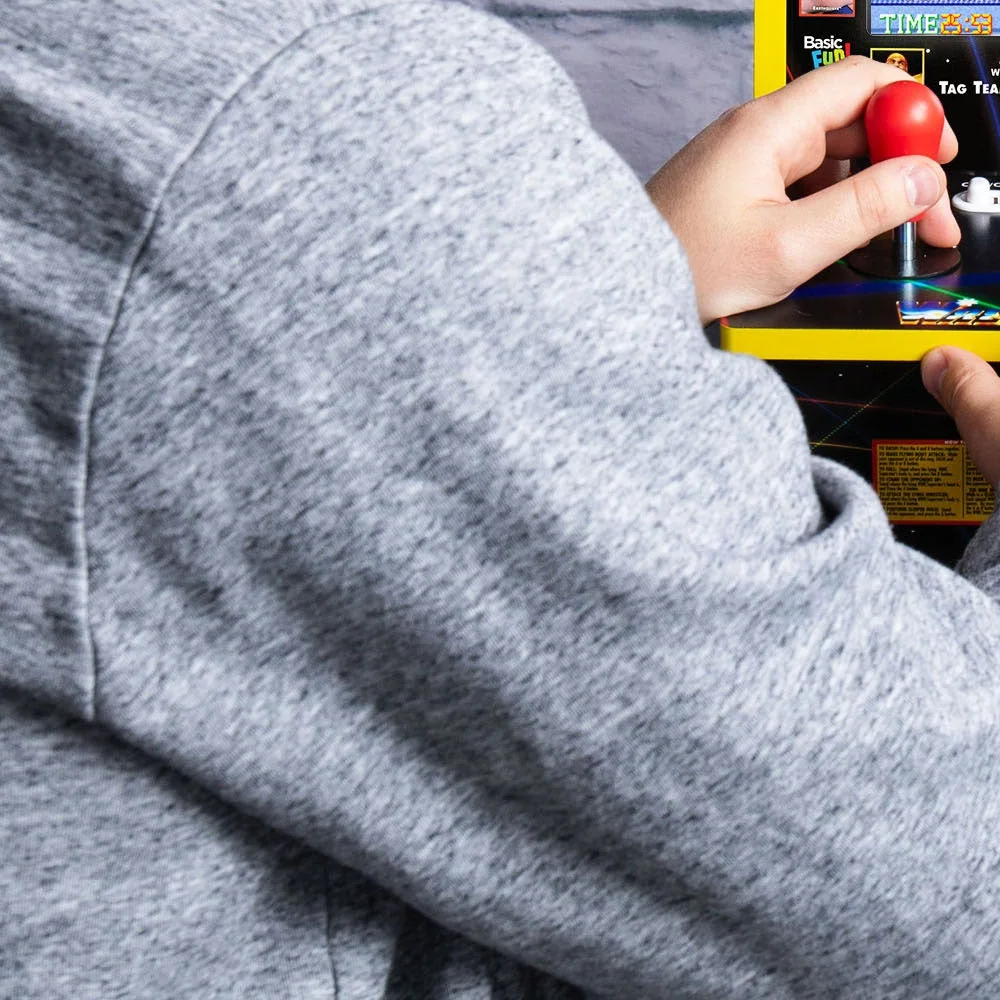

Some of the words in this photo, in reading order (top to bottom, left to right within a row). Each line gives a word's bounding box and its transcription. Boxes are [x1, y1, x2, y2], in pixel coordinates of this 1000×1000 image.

[879, 13, 940, 34] TIME
[940, 13, 993, 34] 25:53
[803, 35, 843, 49] Basic
